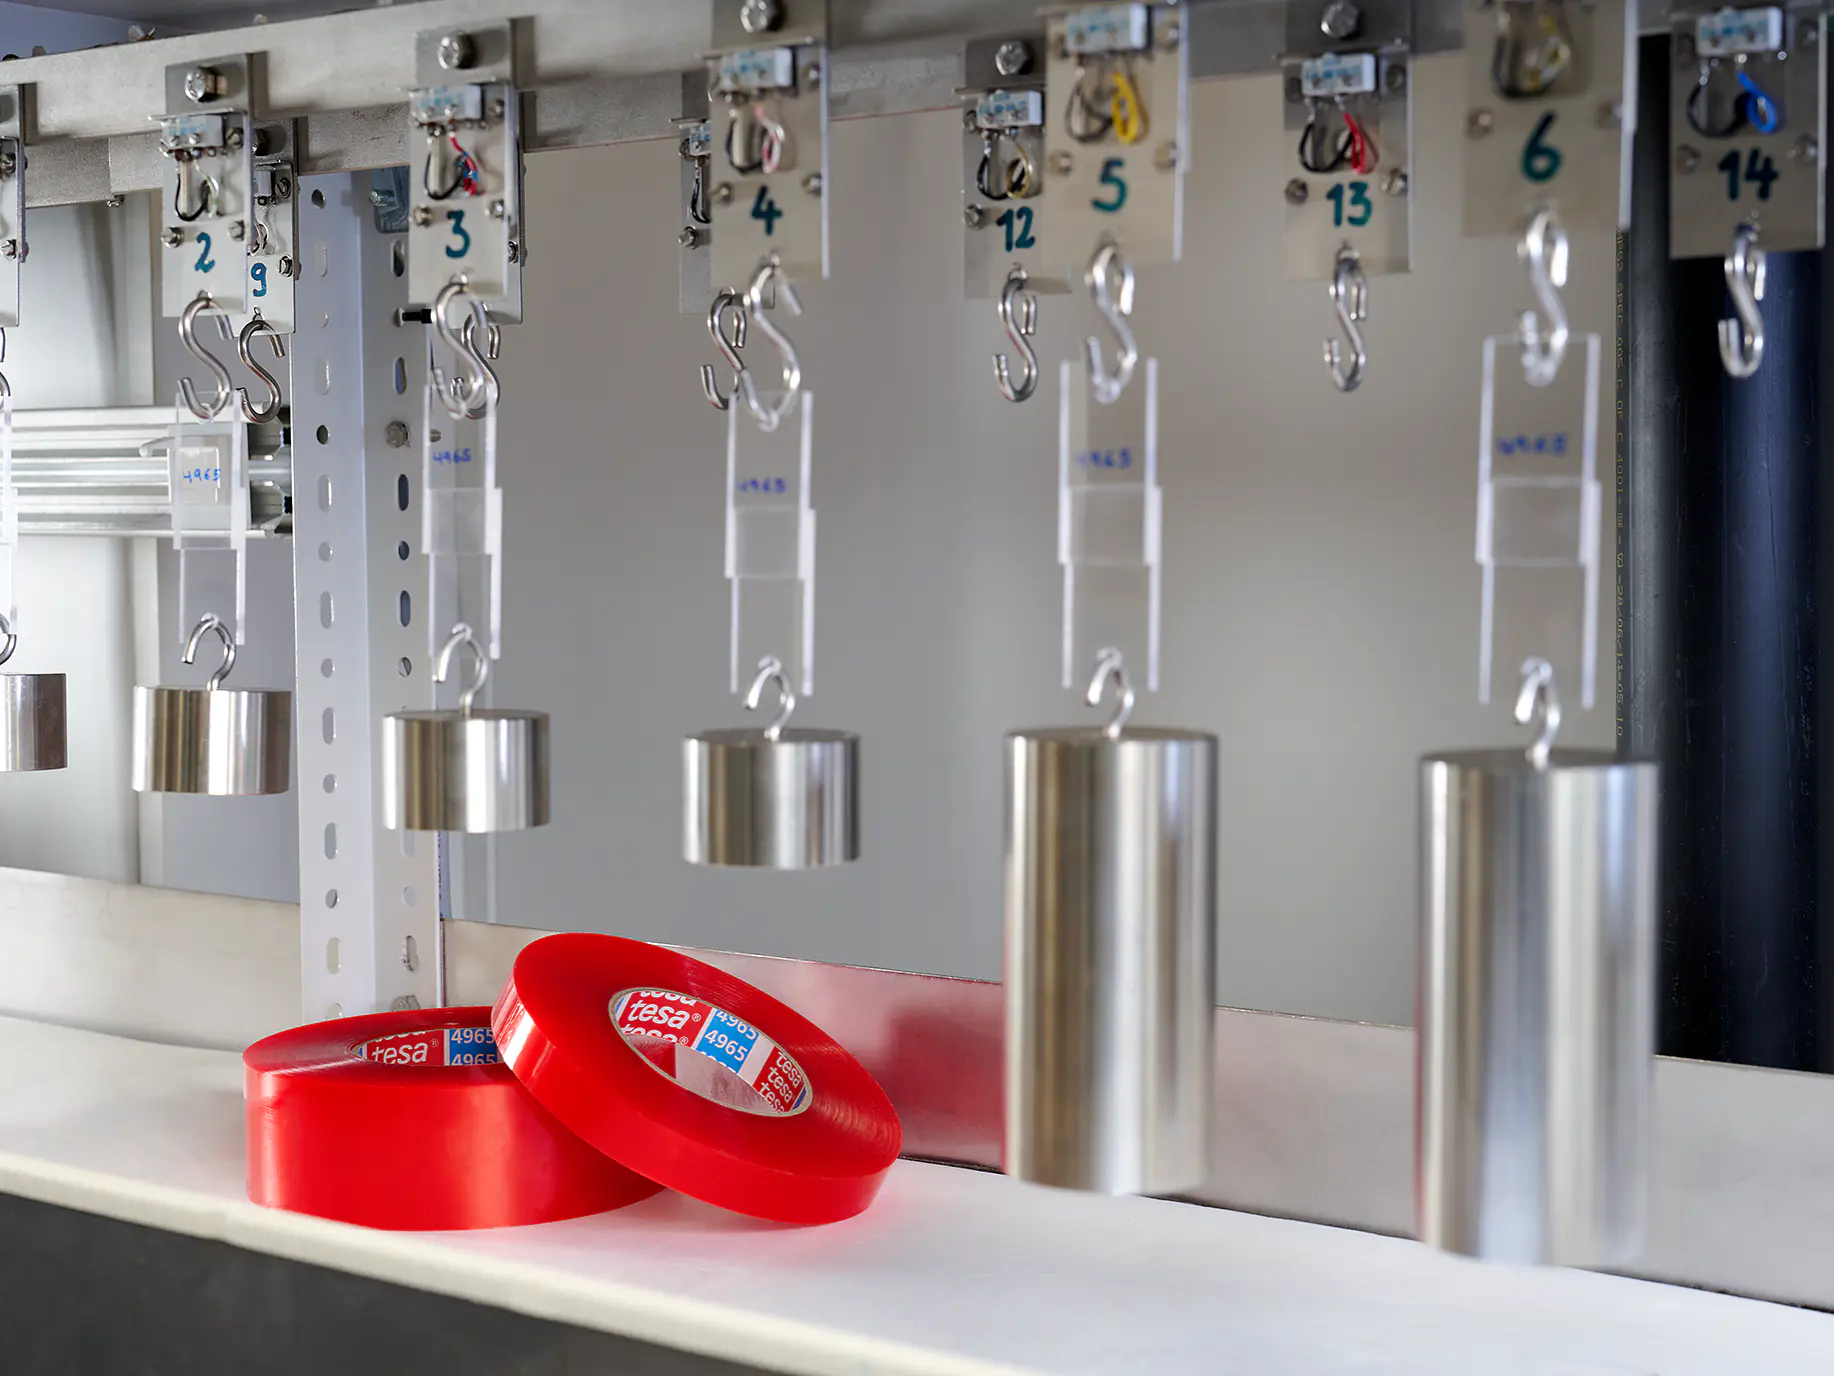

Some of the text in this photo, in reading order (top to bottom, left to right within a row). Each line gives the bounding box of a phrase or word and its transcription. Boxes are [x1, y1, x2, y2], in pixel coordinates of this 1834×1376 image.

[1521, 111, 1563, 183] 6
[1091, 157, 1128, 213] 5
[1718, 146, 1779, 201] 14
[751, 185, 783, 236] 4
[1325, 181, 1373, 228] 13
[445, 210, 471, 258] 3
[996, 207, 1036, 252] 12
[195, 231, 215, 273] 2
[251, 262, 267, 297] 9
[183, 468, 220, 483] 4965
[433, 448, 472, 464] 4965
[705, 1030, 748, 1061] 4965
[768, 1067, 793, 1104] tesa
[776, 1051, 802, 1088] tesa
